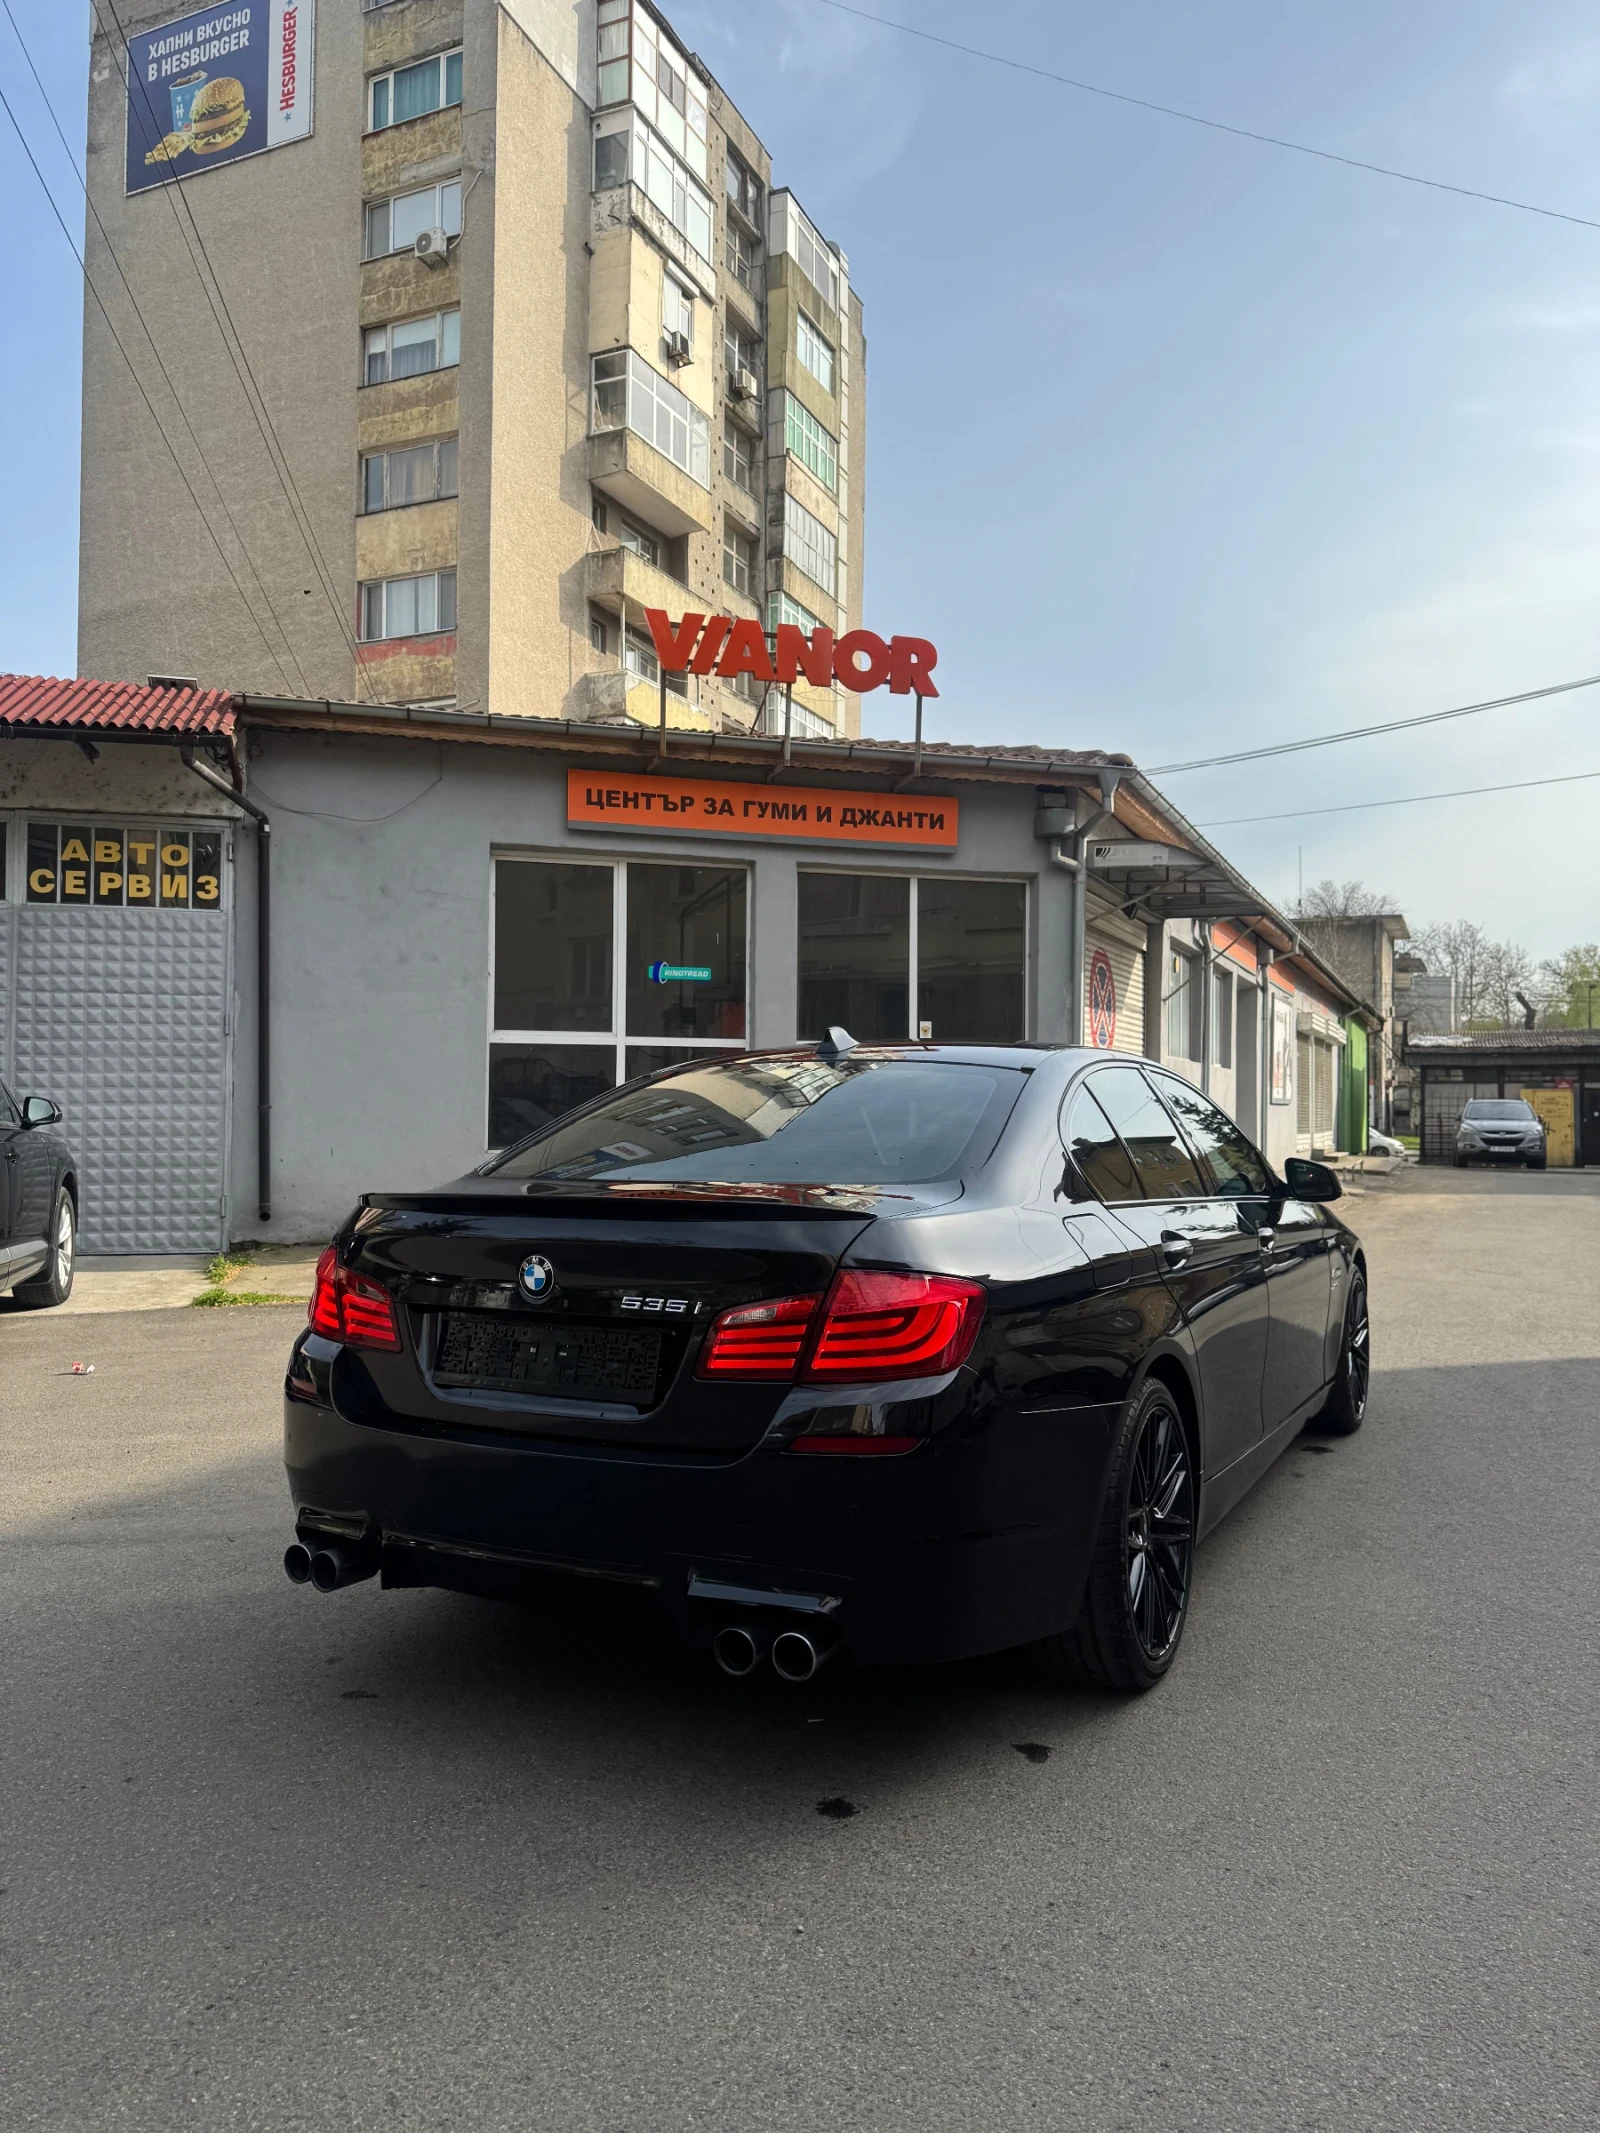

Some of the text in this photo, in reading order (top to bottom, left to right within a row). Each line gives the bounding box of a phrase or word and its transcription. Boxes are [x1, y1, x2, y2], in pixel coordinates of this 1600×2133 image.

[147, 29, 250, 82] В HESBURGER
[148, 8, 251, 60] ХАПНИ ВКУСНО
[280, 6, 298, 111] HESBURGER
[643, 608, 940, 698] VIANOR
[585, 788, 945, 830] ЦЕНТЪР ЗА ГУМИ И ДЖАНТИ
[61, 839, 190, 867] АВТО
[29, 868, 219, 900] СЕРВИЗ
[521, 1256, 552, 1271] BMW
